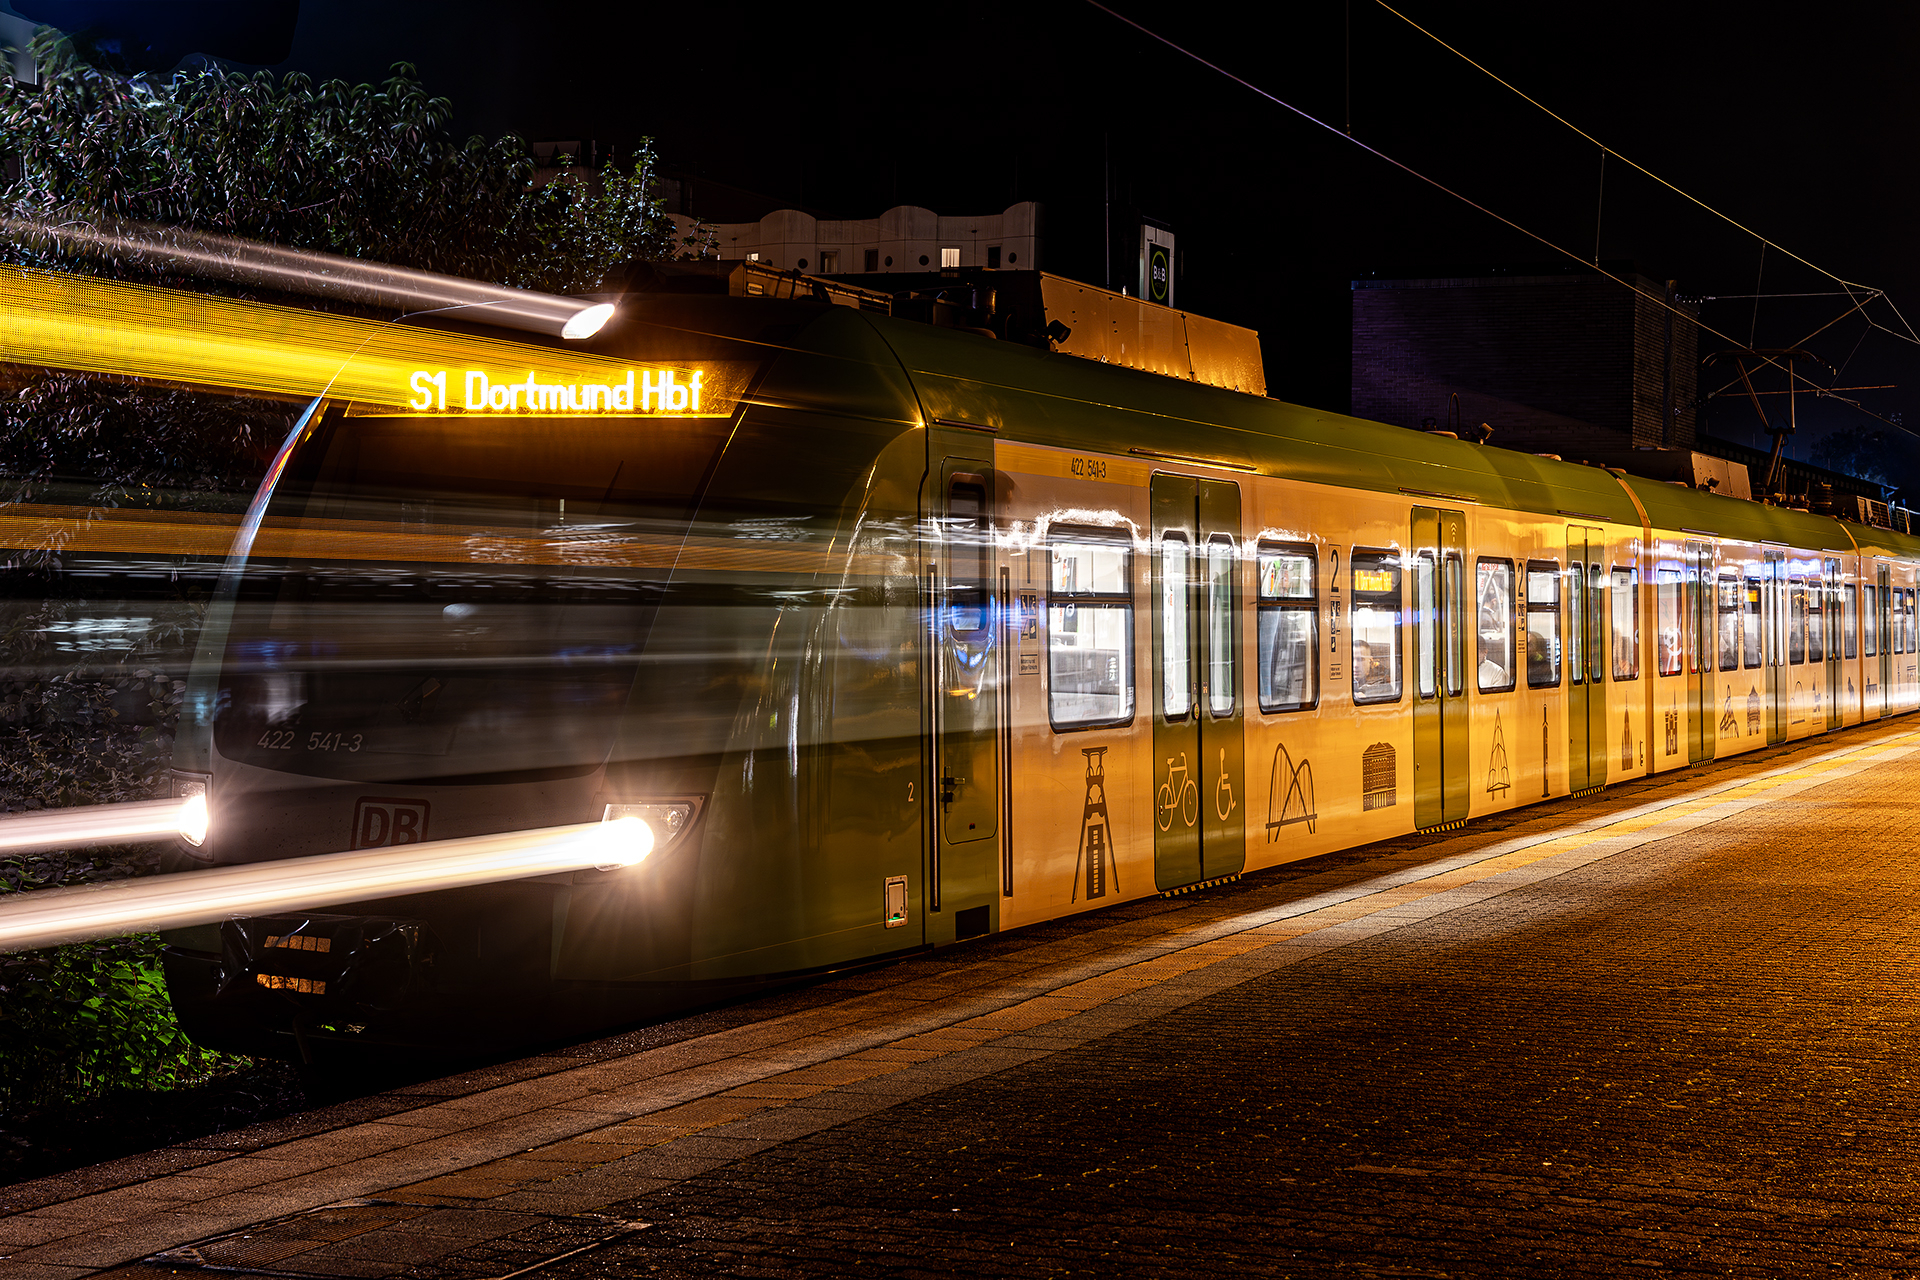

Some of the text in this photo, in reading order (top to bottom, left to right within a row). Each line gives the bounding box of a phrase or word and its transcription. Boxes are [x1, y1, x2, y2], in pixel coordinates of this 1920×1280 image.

[1153, 265, 1166, 282] B&B
[409, 370, 703, 411] S1 Dortmund Hbf
[1071, 457, 1107, 478] 422 541-3
[1330, 549, 1339, 593] 2
[1517, 562, 1524, 597] 2
[257, 730, 363, 752] 422 541-3
[907, 781, 914, 802] 2
[359, 805, 420, 848] DB
